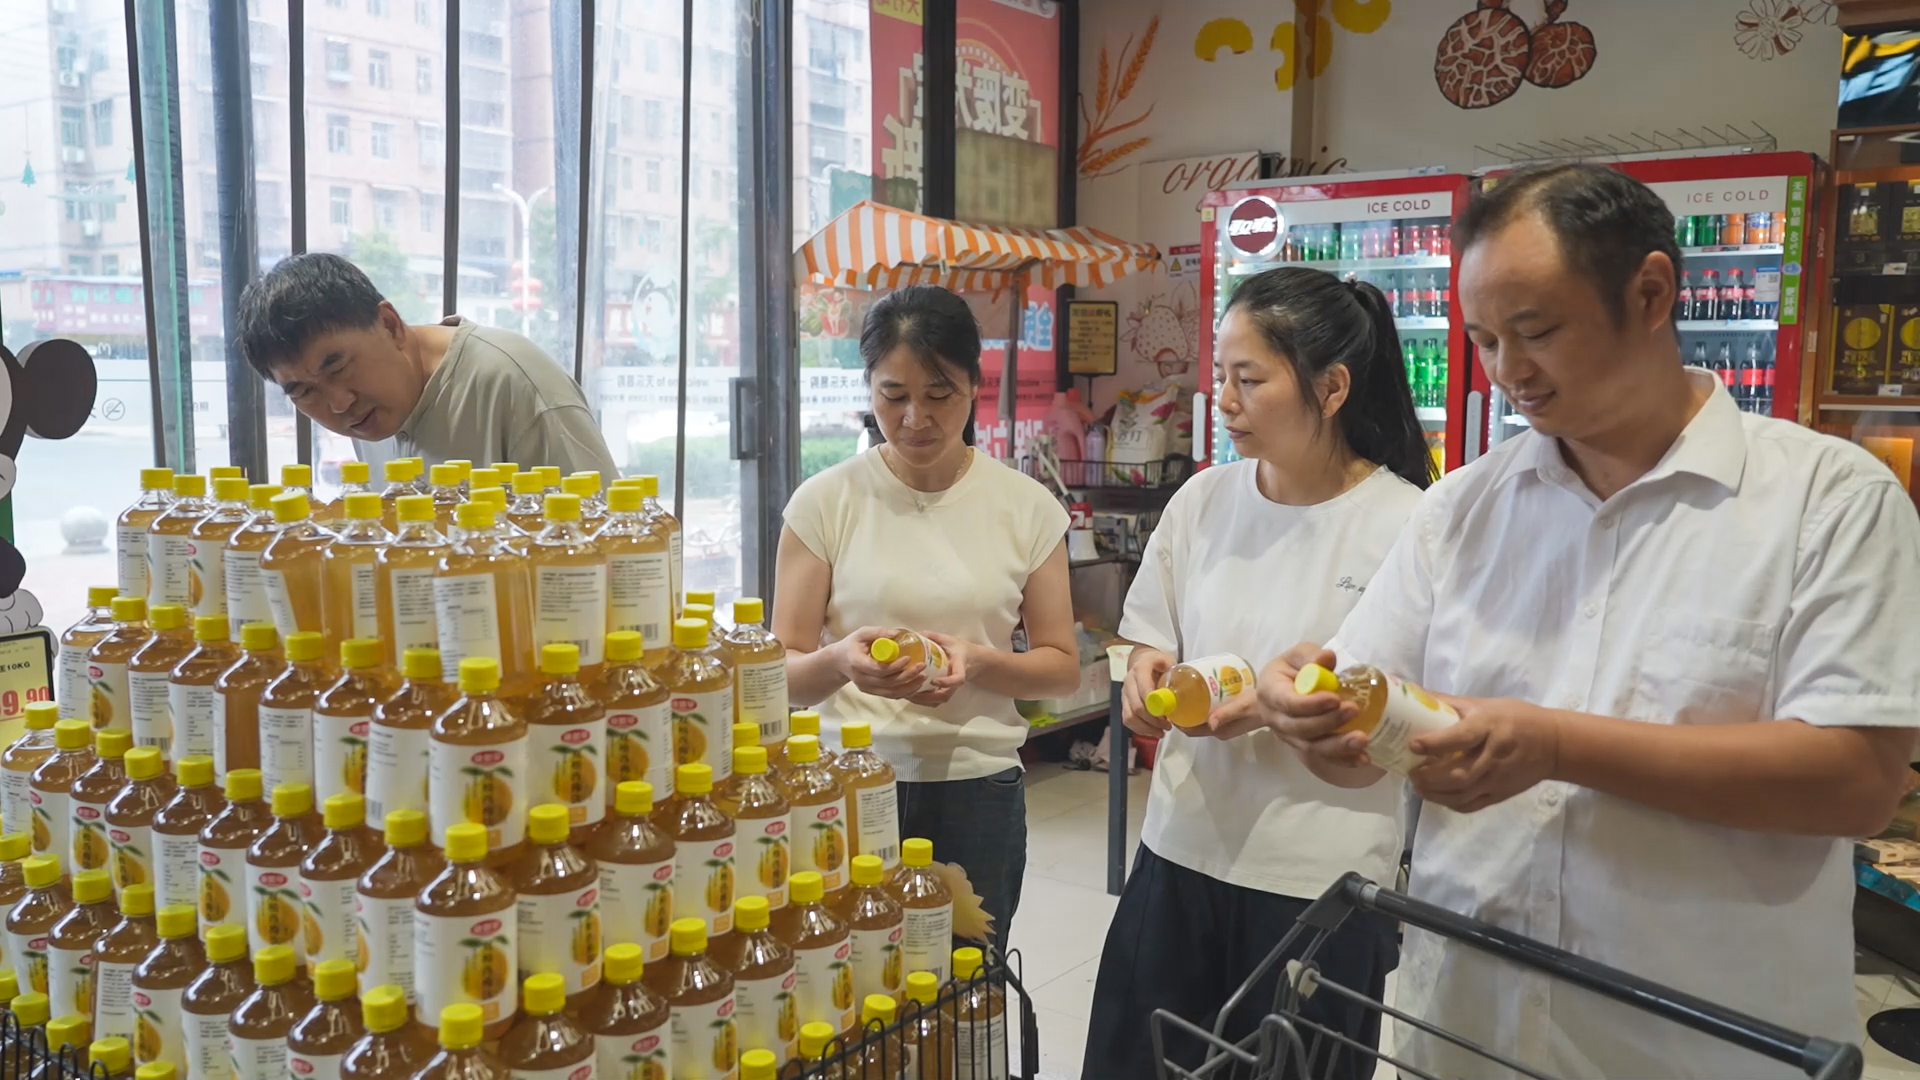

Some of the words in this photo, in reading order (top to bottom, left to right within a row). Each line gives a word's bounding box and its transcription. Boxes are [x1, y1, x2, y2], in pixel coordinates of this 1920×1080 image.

[1687, 192, 1714, 204] ICE
[1723, 189, 1769, 202] COLD
[1367, 202, 1389, 214] ICE
[1393, 199, 1431, 212] COLD
[0, 686, 50, 716] 9.90
